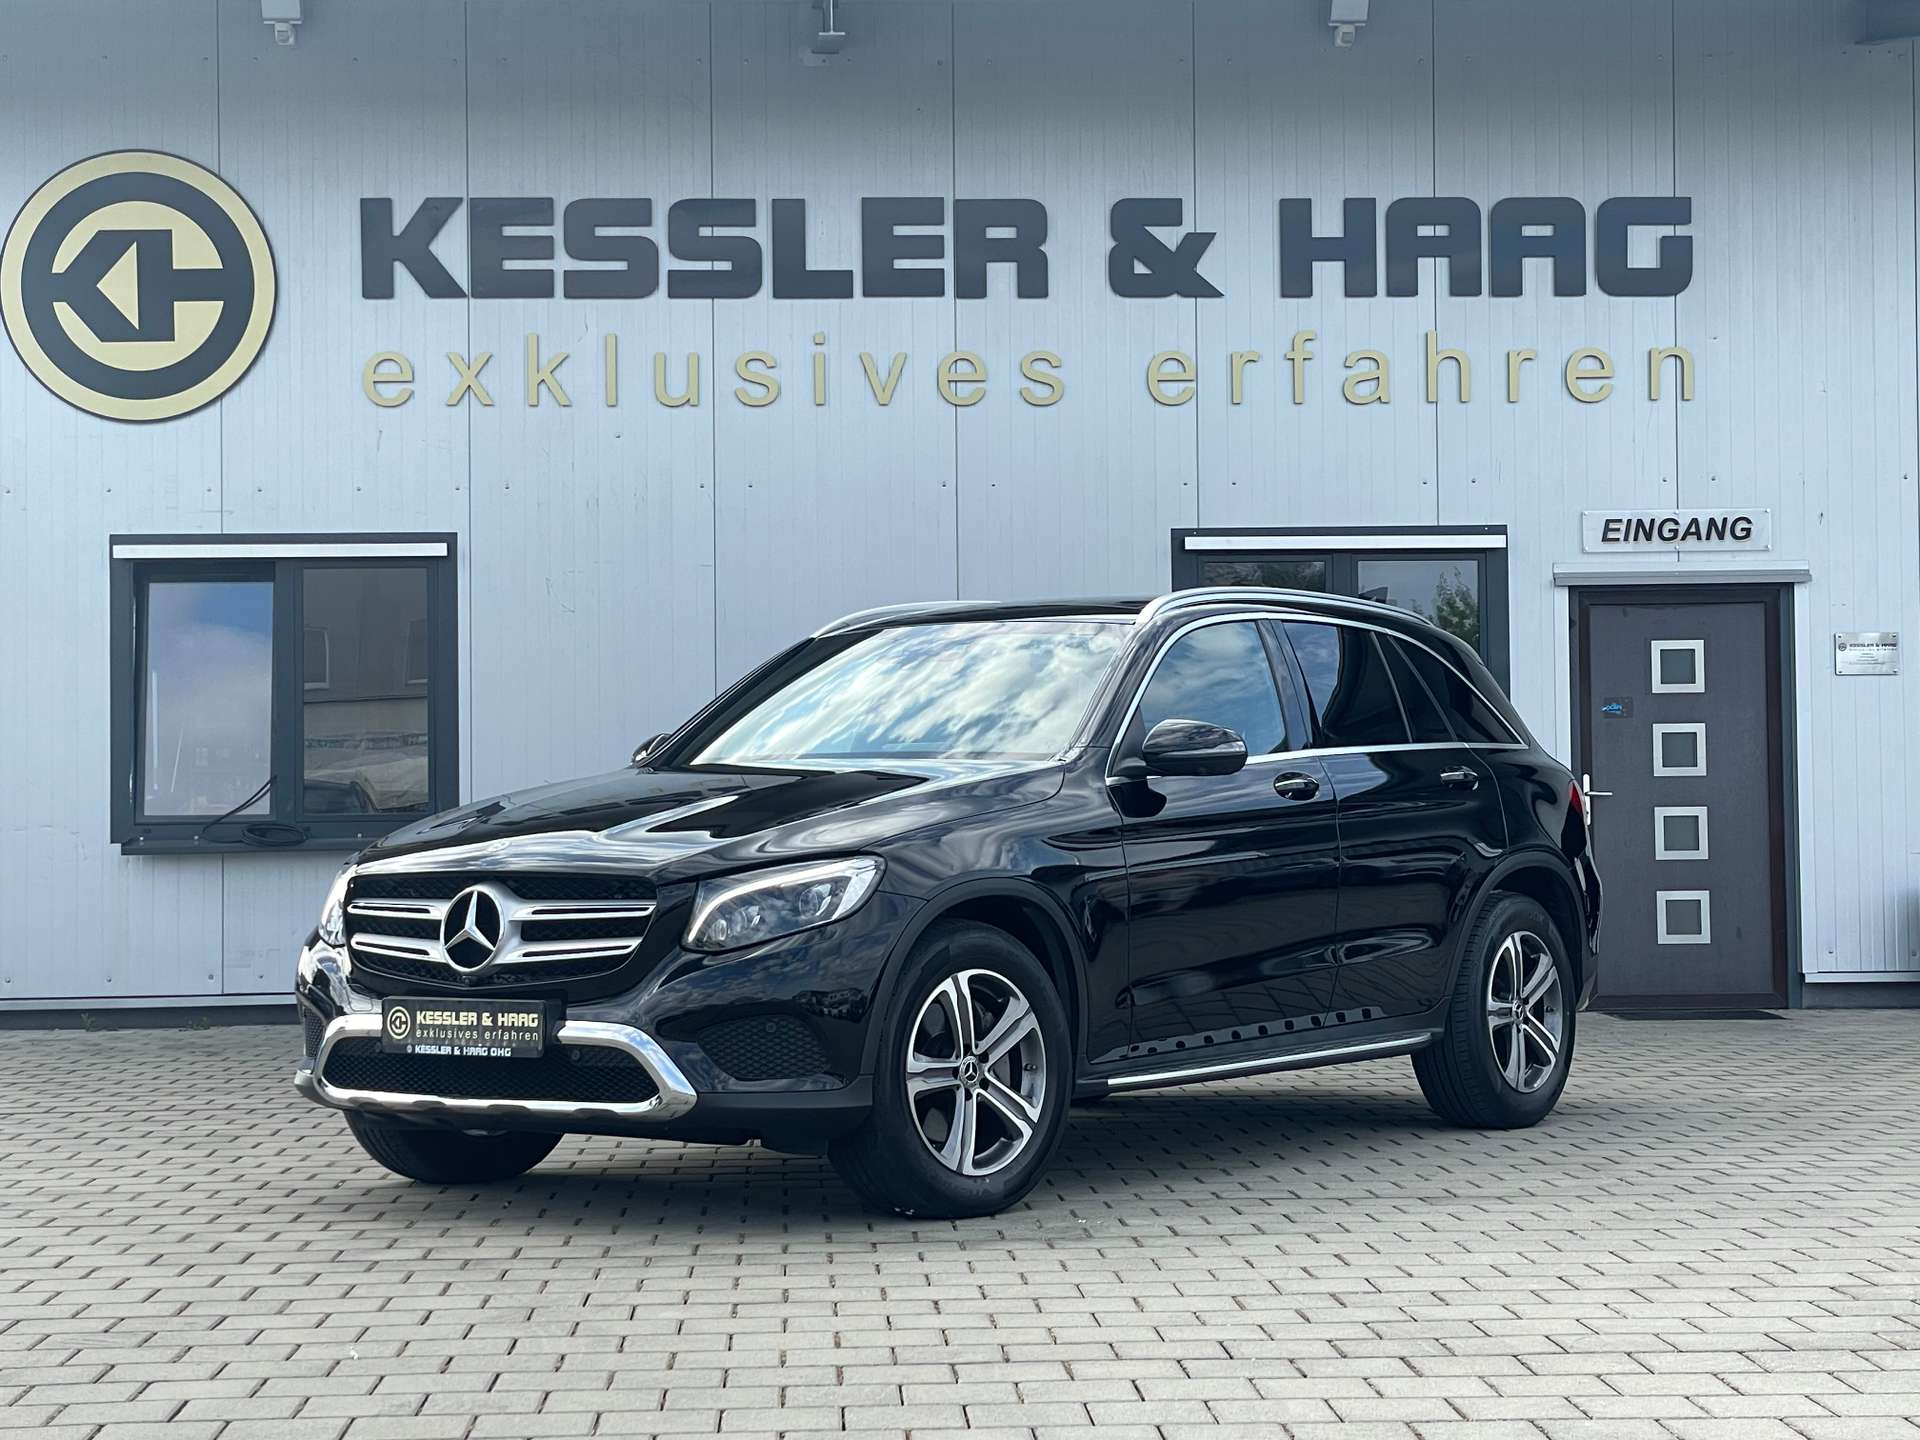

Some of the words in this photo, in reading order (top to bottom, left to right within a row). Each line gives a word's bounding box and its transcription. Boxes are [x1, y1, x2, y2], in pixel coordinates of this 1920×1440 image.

[360, 197, 1049, 299] KESSLER
[1108, 198, 1224, 298] &
[1279, 197, 1693, 297] HAAG
[361, 332, 1065, 408] exklusives
[1147, 330, 1696, 405] erfahren
[1601, 516, 1753, 542] EINGANG
[416, 1011, 478, 1026] KESSLER
[481, 1012, 493, 1026] &
[497, 1012, 539, 1027] HAAG
[416, 1027, 478, 1039] exklusives
[484, 1028, 539, 1041] erfahren
[415, 1044, 452, 1055] KESSLER
[454, 1046, 461, 1055] &
[463, 1046, 488, 1056] HAAG
[490, 1047, 511, 1057] OHG
